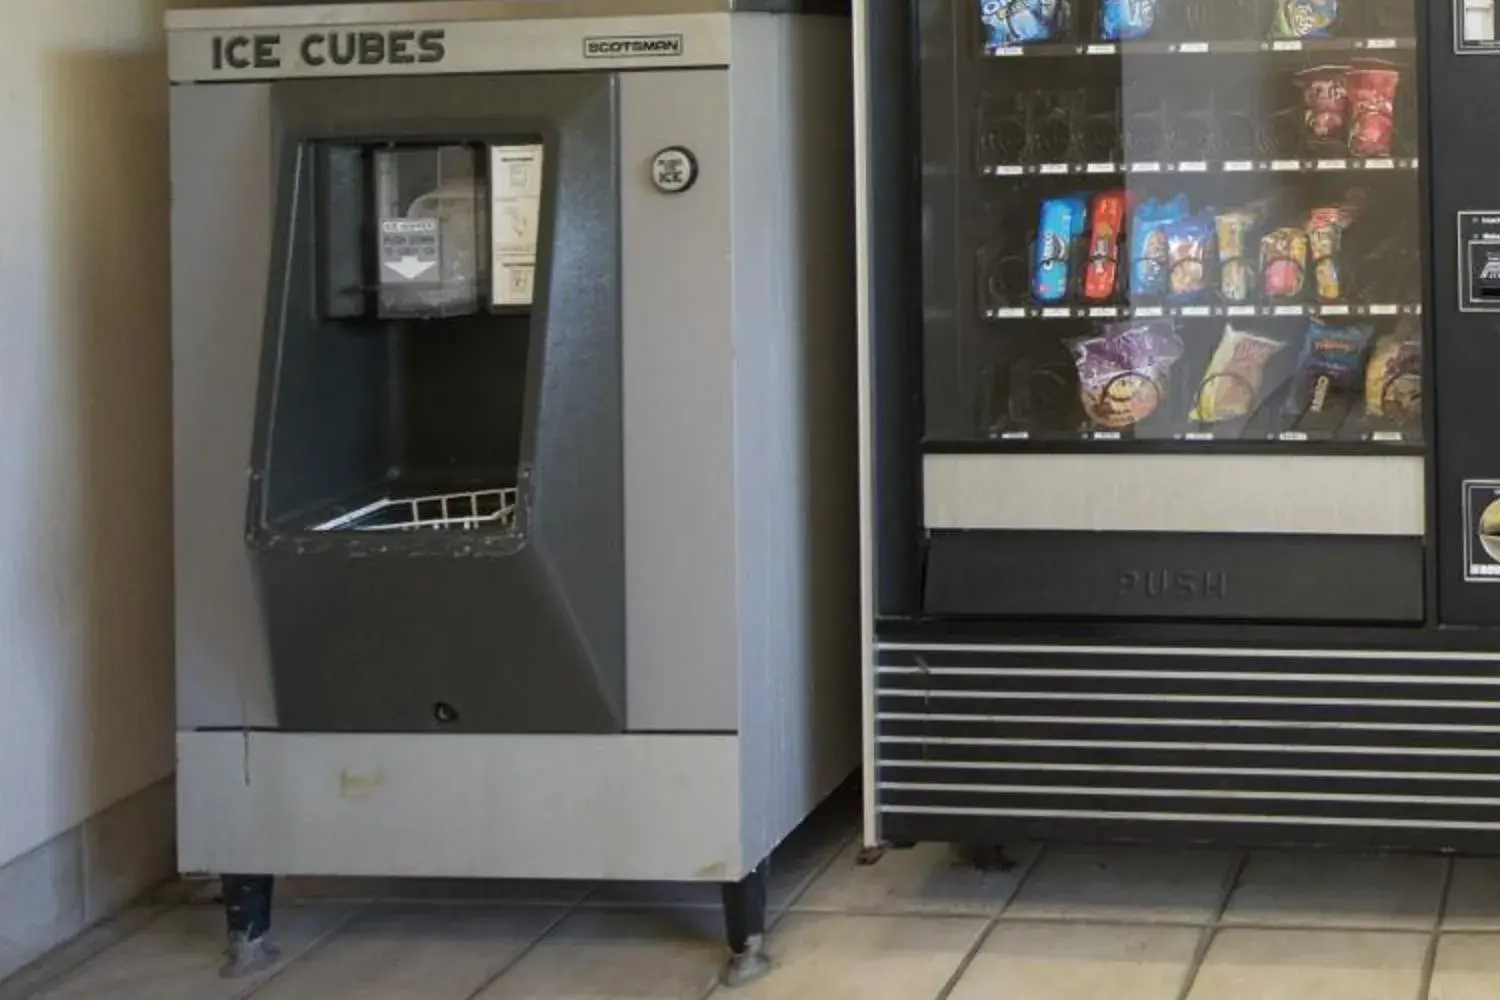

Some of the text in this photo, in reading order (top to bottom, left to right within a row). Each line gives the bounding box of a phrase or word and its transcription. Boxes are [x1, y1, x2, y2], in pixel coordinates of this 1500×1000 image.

[212, 28, 446, 70] ICE CUBES
[587, 40, 680, 54] SCOTSMAN
[1118, 567, 1228, 598] PUSH
